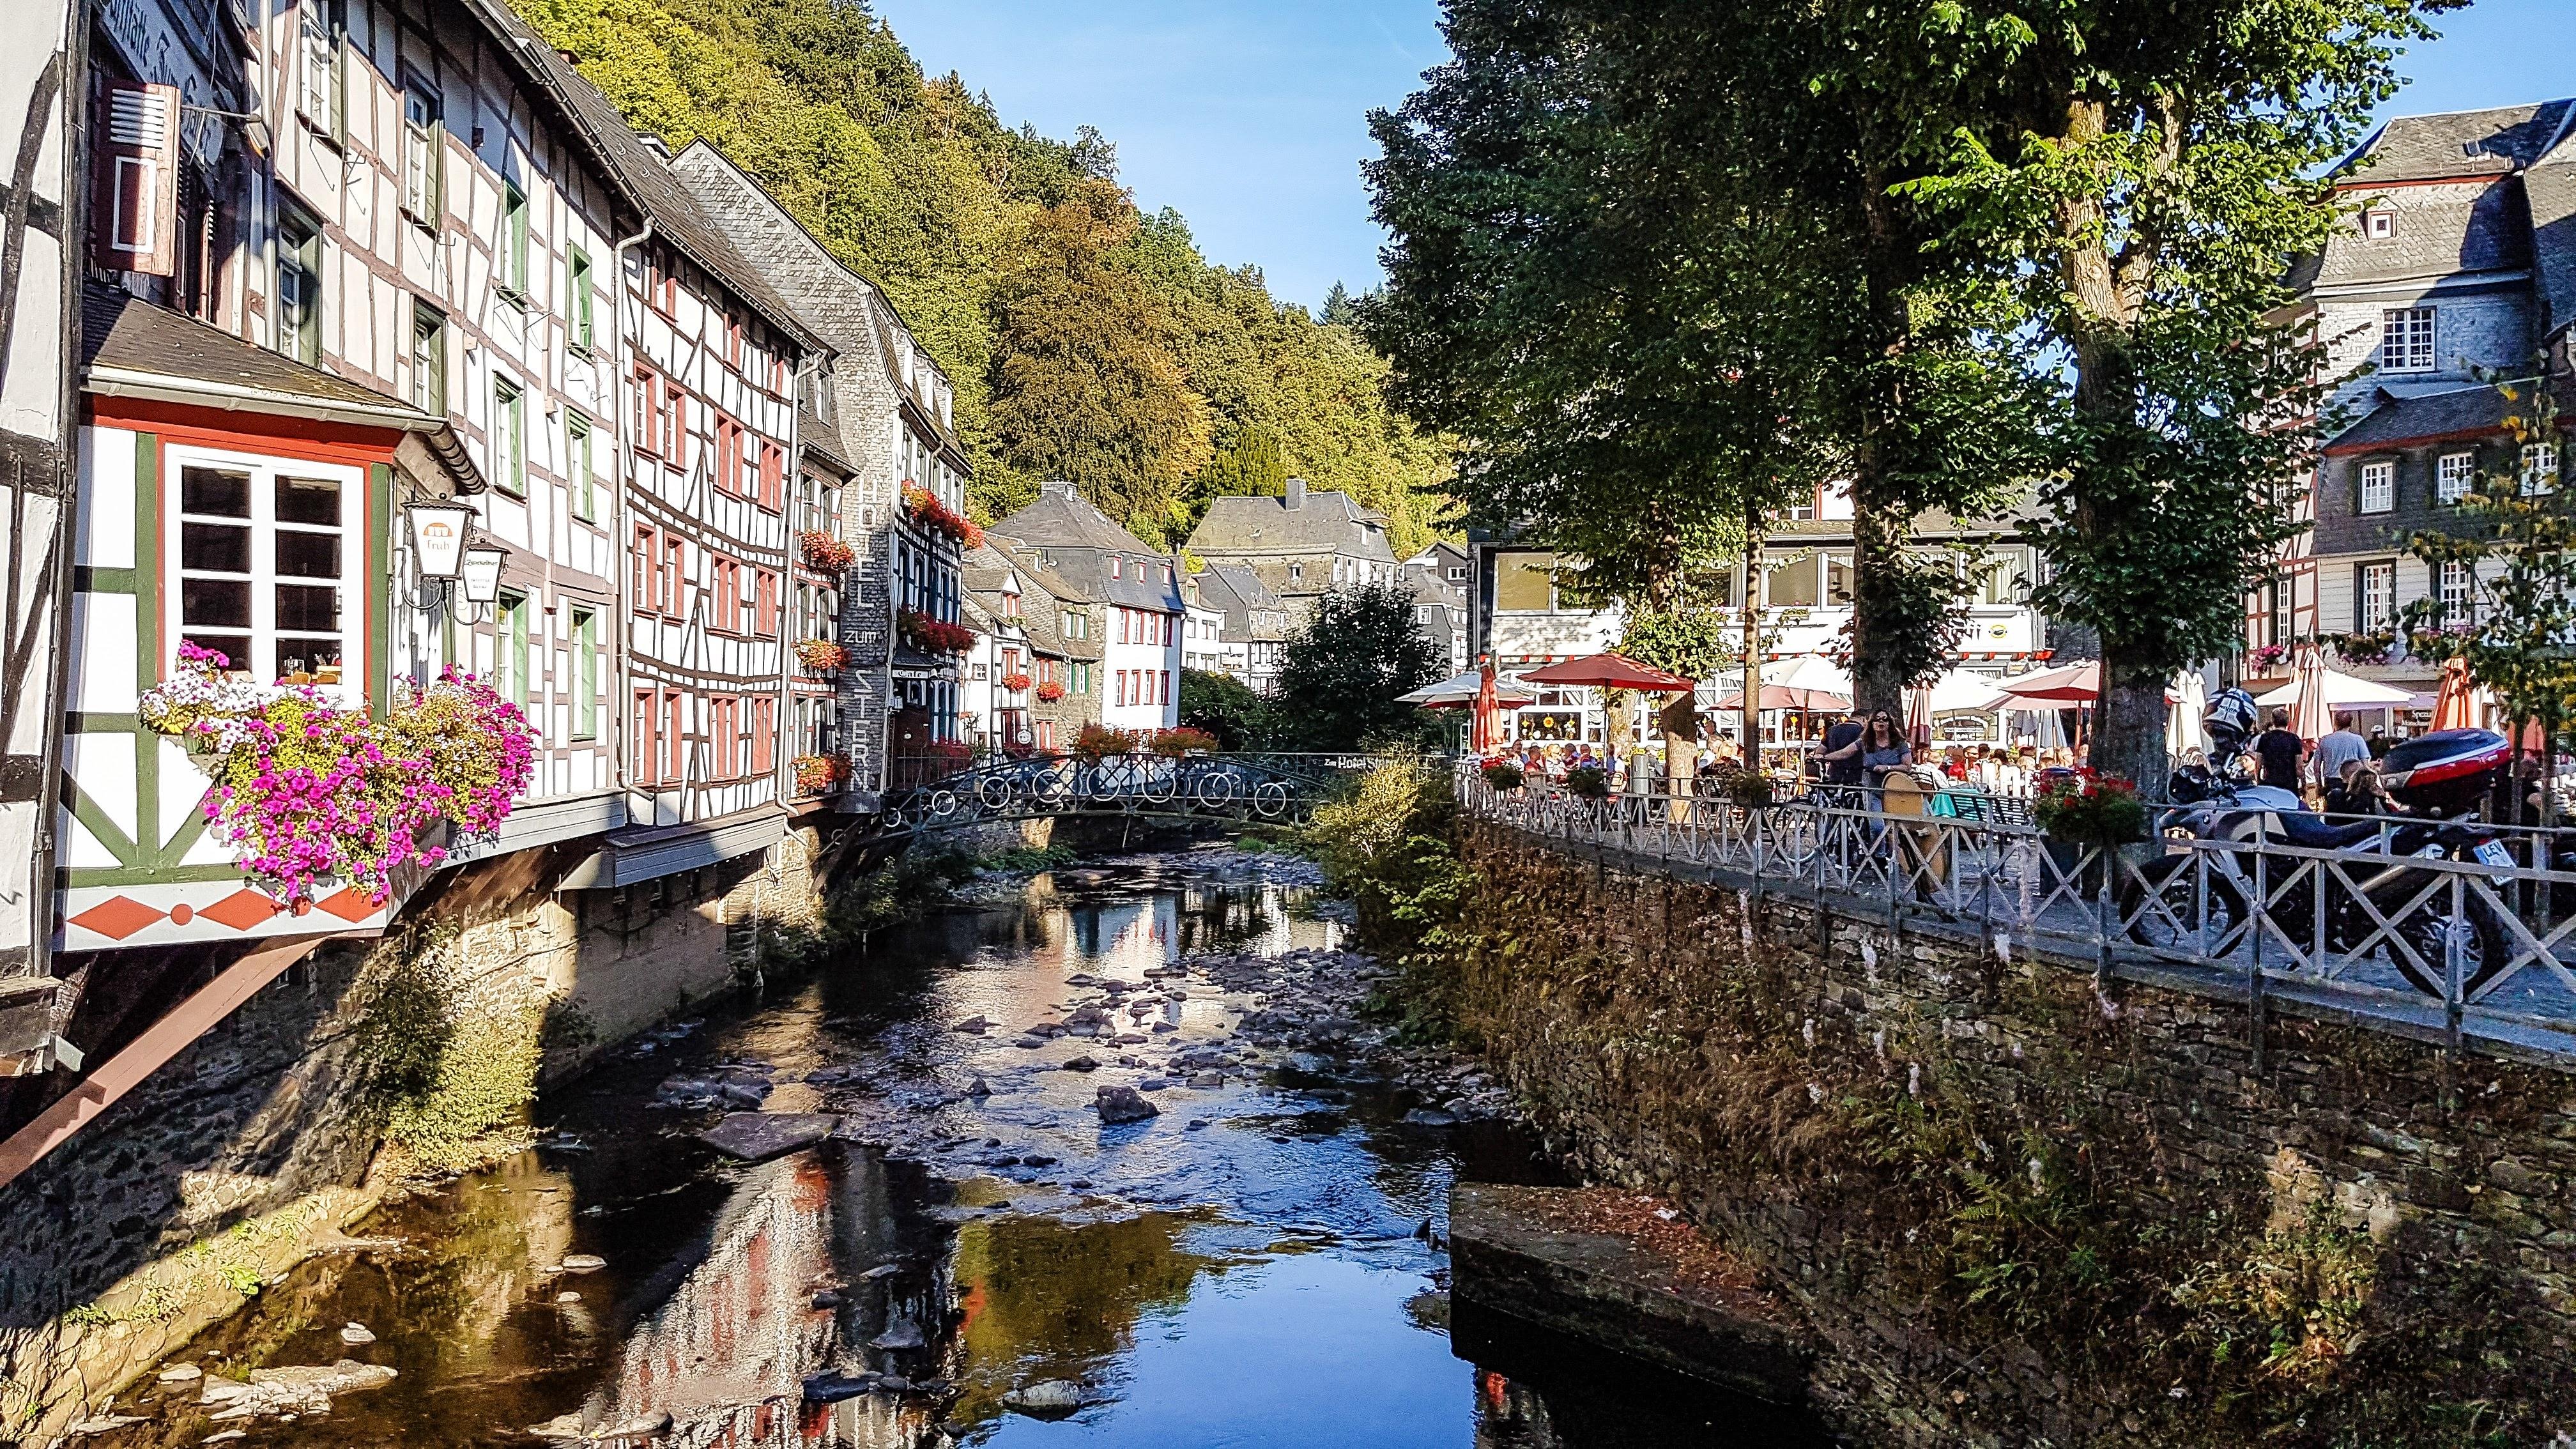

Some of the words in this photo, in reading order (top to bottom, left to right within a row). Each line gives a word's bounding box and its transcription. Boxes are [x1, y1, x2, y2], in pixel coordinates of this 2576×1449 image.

[857, 476, 878, 608] HOTEL
[850, 670, 873, 792] STERN
[1338, 756, 1366, 769] Hotel
[2482, 841, 2503, 857] LEV
